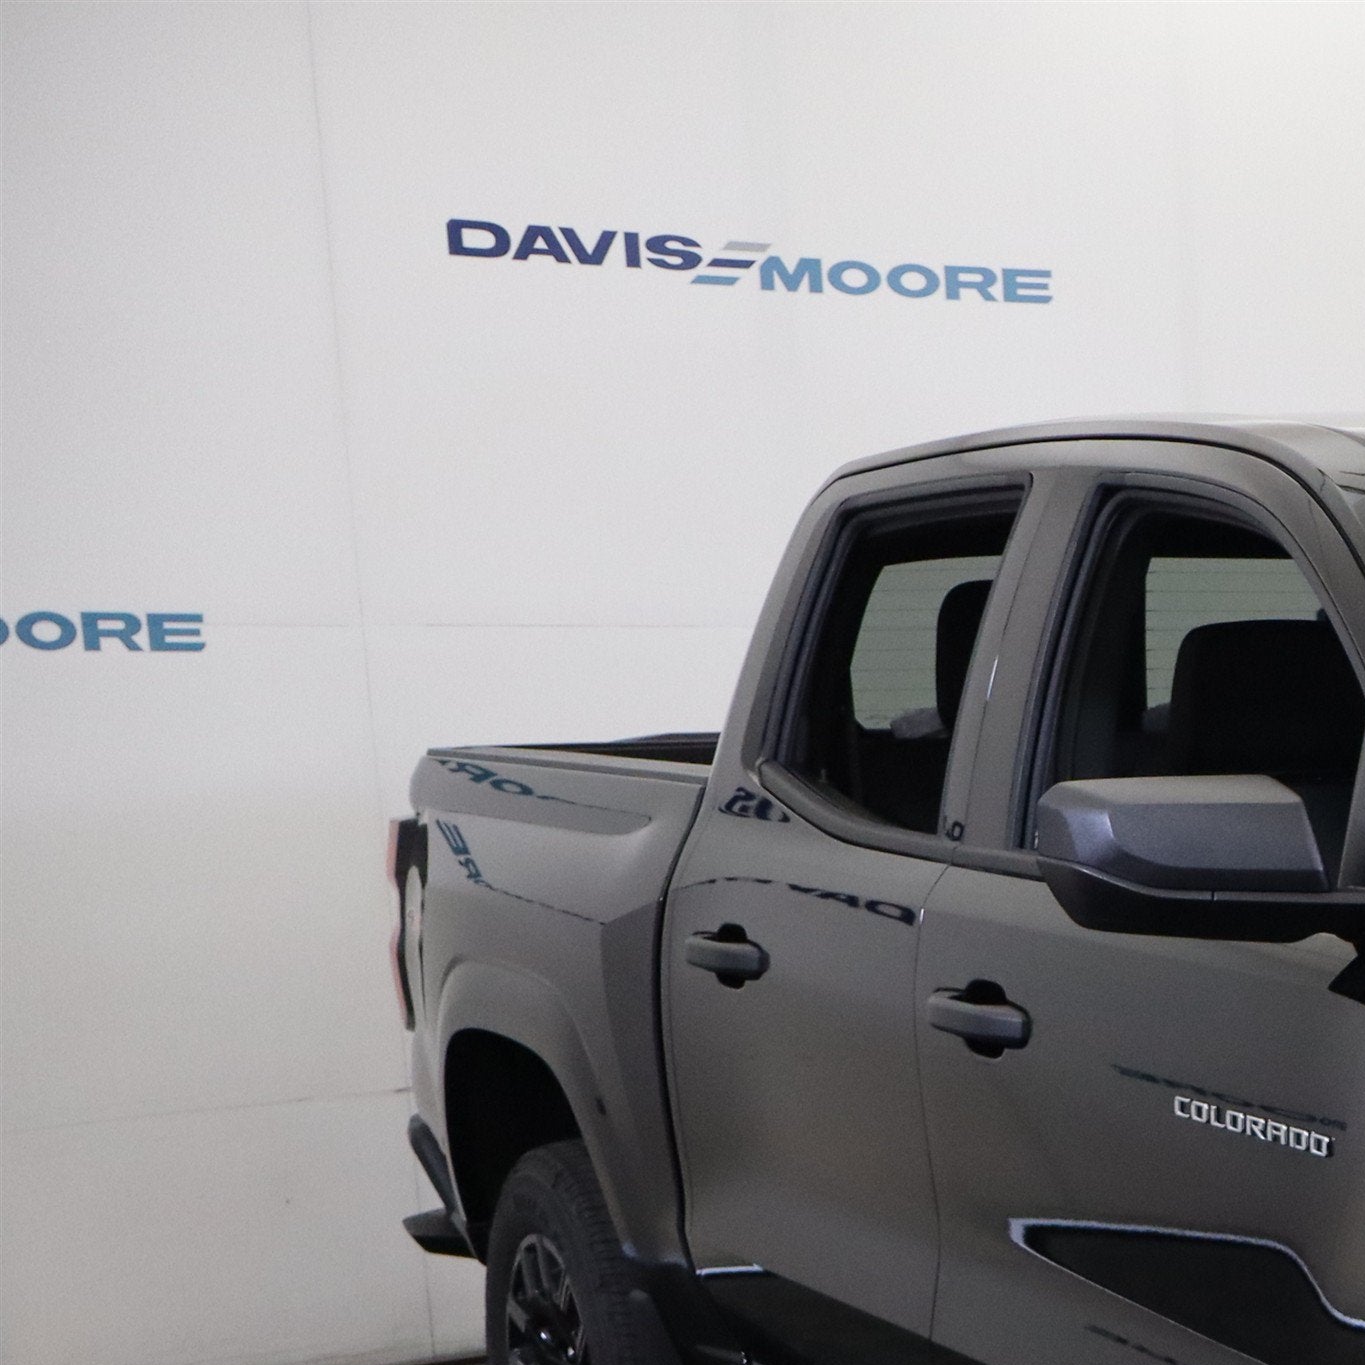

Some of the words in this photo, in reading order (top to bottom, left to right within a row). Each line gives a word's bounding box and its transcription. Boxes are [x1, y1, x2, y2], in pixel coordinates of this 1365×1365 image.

[445, 217, 703, 271] DAVIS
[758, 254, 1053, 304] MOORE
[0, 610, 206, 652] ORE
[1173, 1095, 1332, 1158] COLORADO
